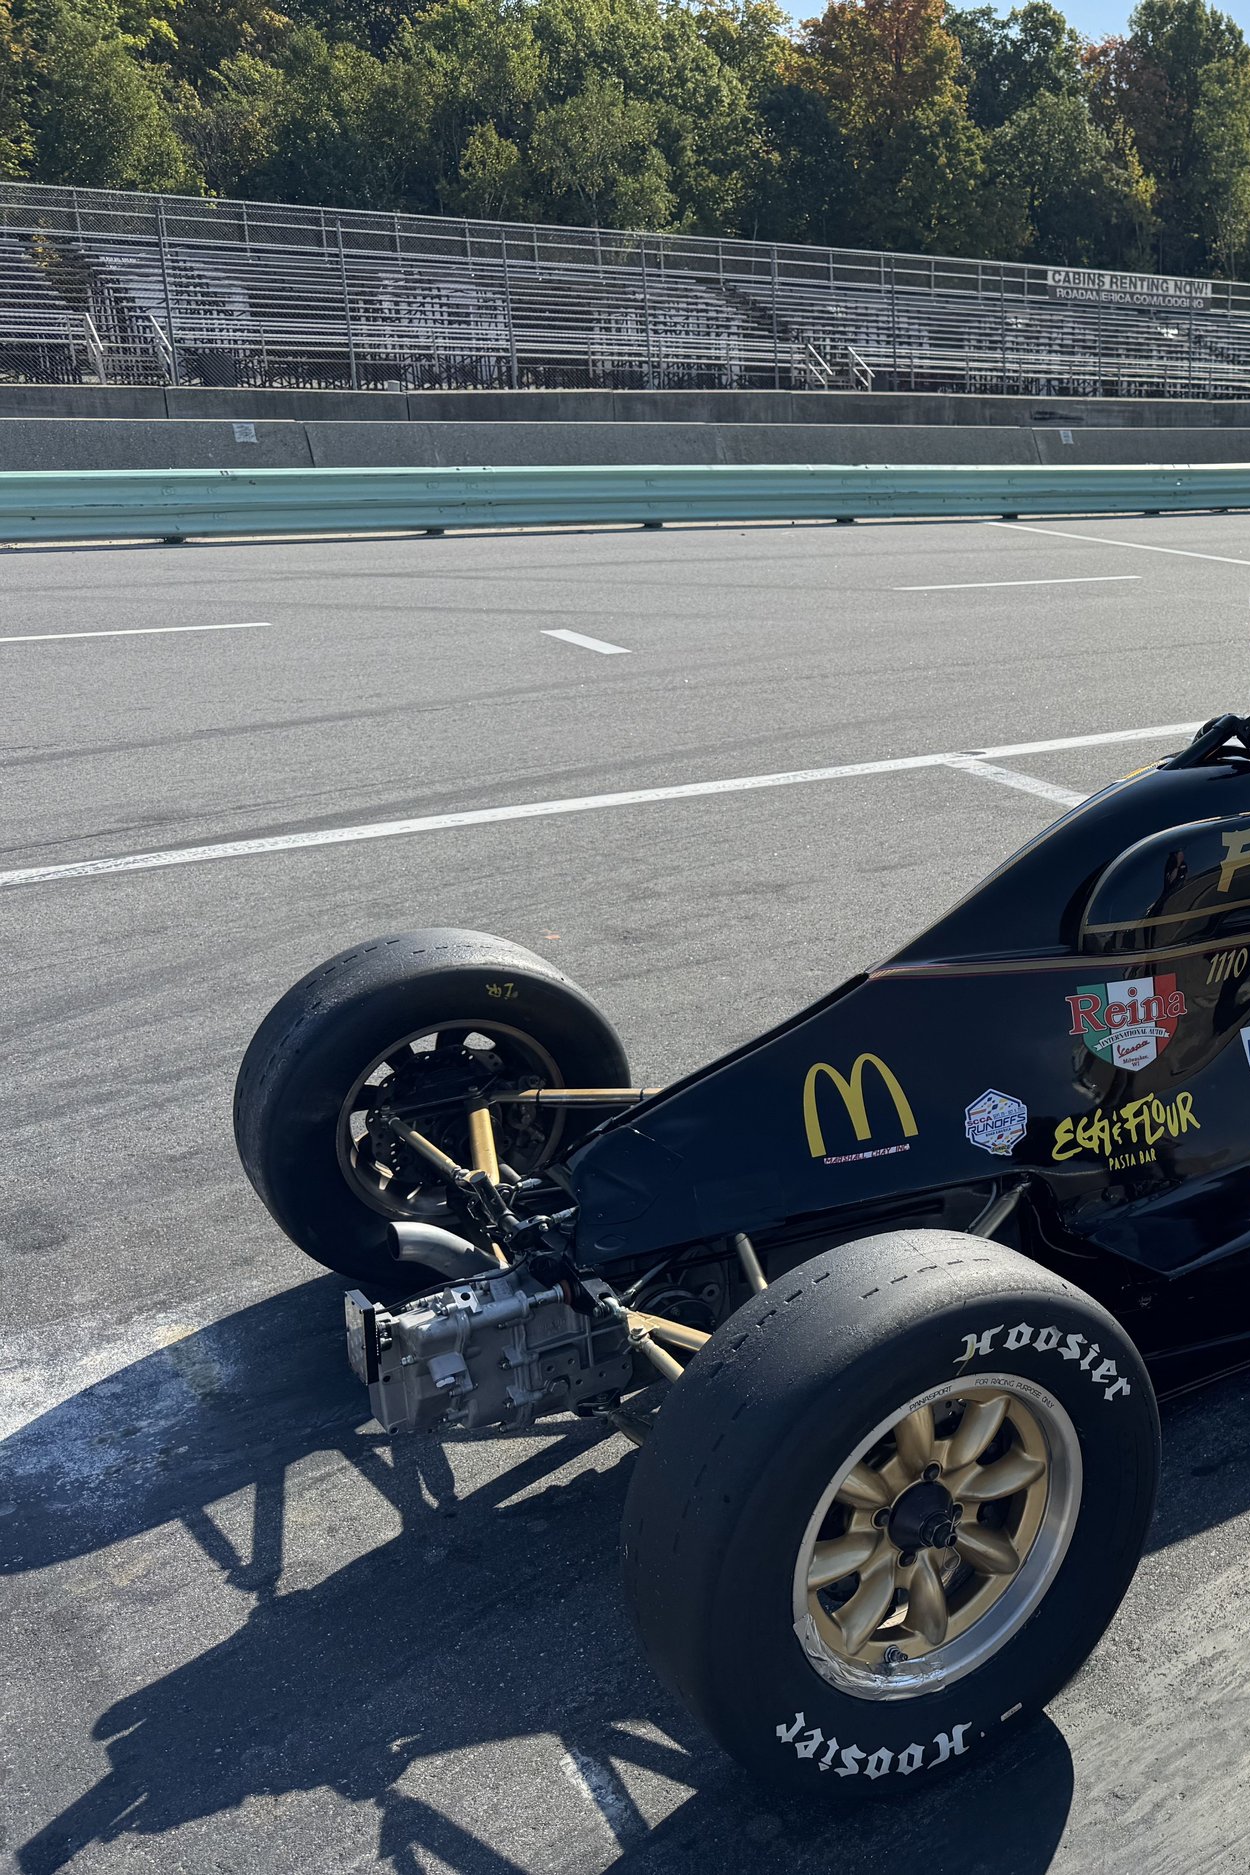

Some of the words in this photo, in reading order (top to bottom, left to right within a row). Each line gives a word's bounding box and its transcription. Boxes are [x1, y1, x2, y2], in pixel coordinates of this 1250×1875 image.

[1052, 271, 1105, 288] CABINS
[1109, 277, 1169, 294] RENTING
[1174, 282, 1209, 296] NOW!
[1206, 947, 1248, 985] 1110
[1065, 986, 1188, 1036] Reina
[1101, 1028, 1147, 1046] INTERNATIONAL
[1116, 1040, 1151, 1059] Vespa
[967, 1116, 993, 1127] SCCA
[968, 1112, 1026, 1137] RUNOFFS
[1119, 1092, 1201, 1146] FLOUR
[1108, 1153, 1137, 1171] PASTA
[1139, 1147, 1157, 1164] BAR
[952, 1321, 1131, 1401] Hoosier
[909, 1385, 953, 1411] PANASPORT
[974, 1378, 988, 1386] FOR
[990, 1378, 1013, 1388] RACING
[1015, 1381, 1042, 1399] PURPOSE
[1041, 1395, 1055, 1409] ONLY
[775, 1711, 973, 1780] Hoosier
